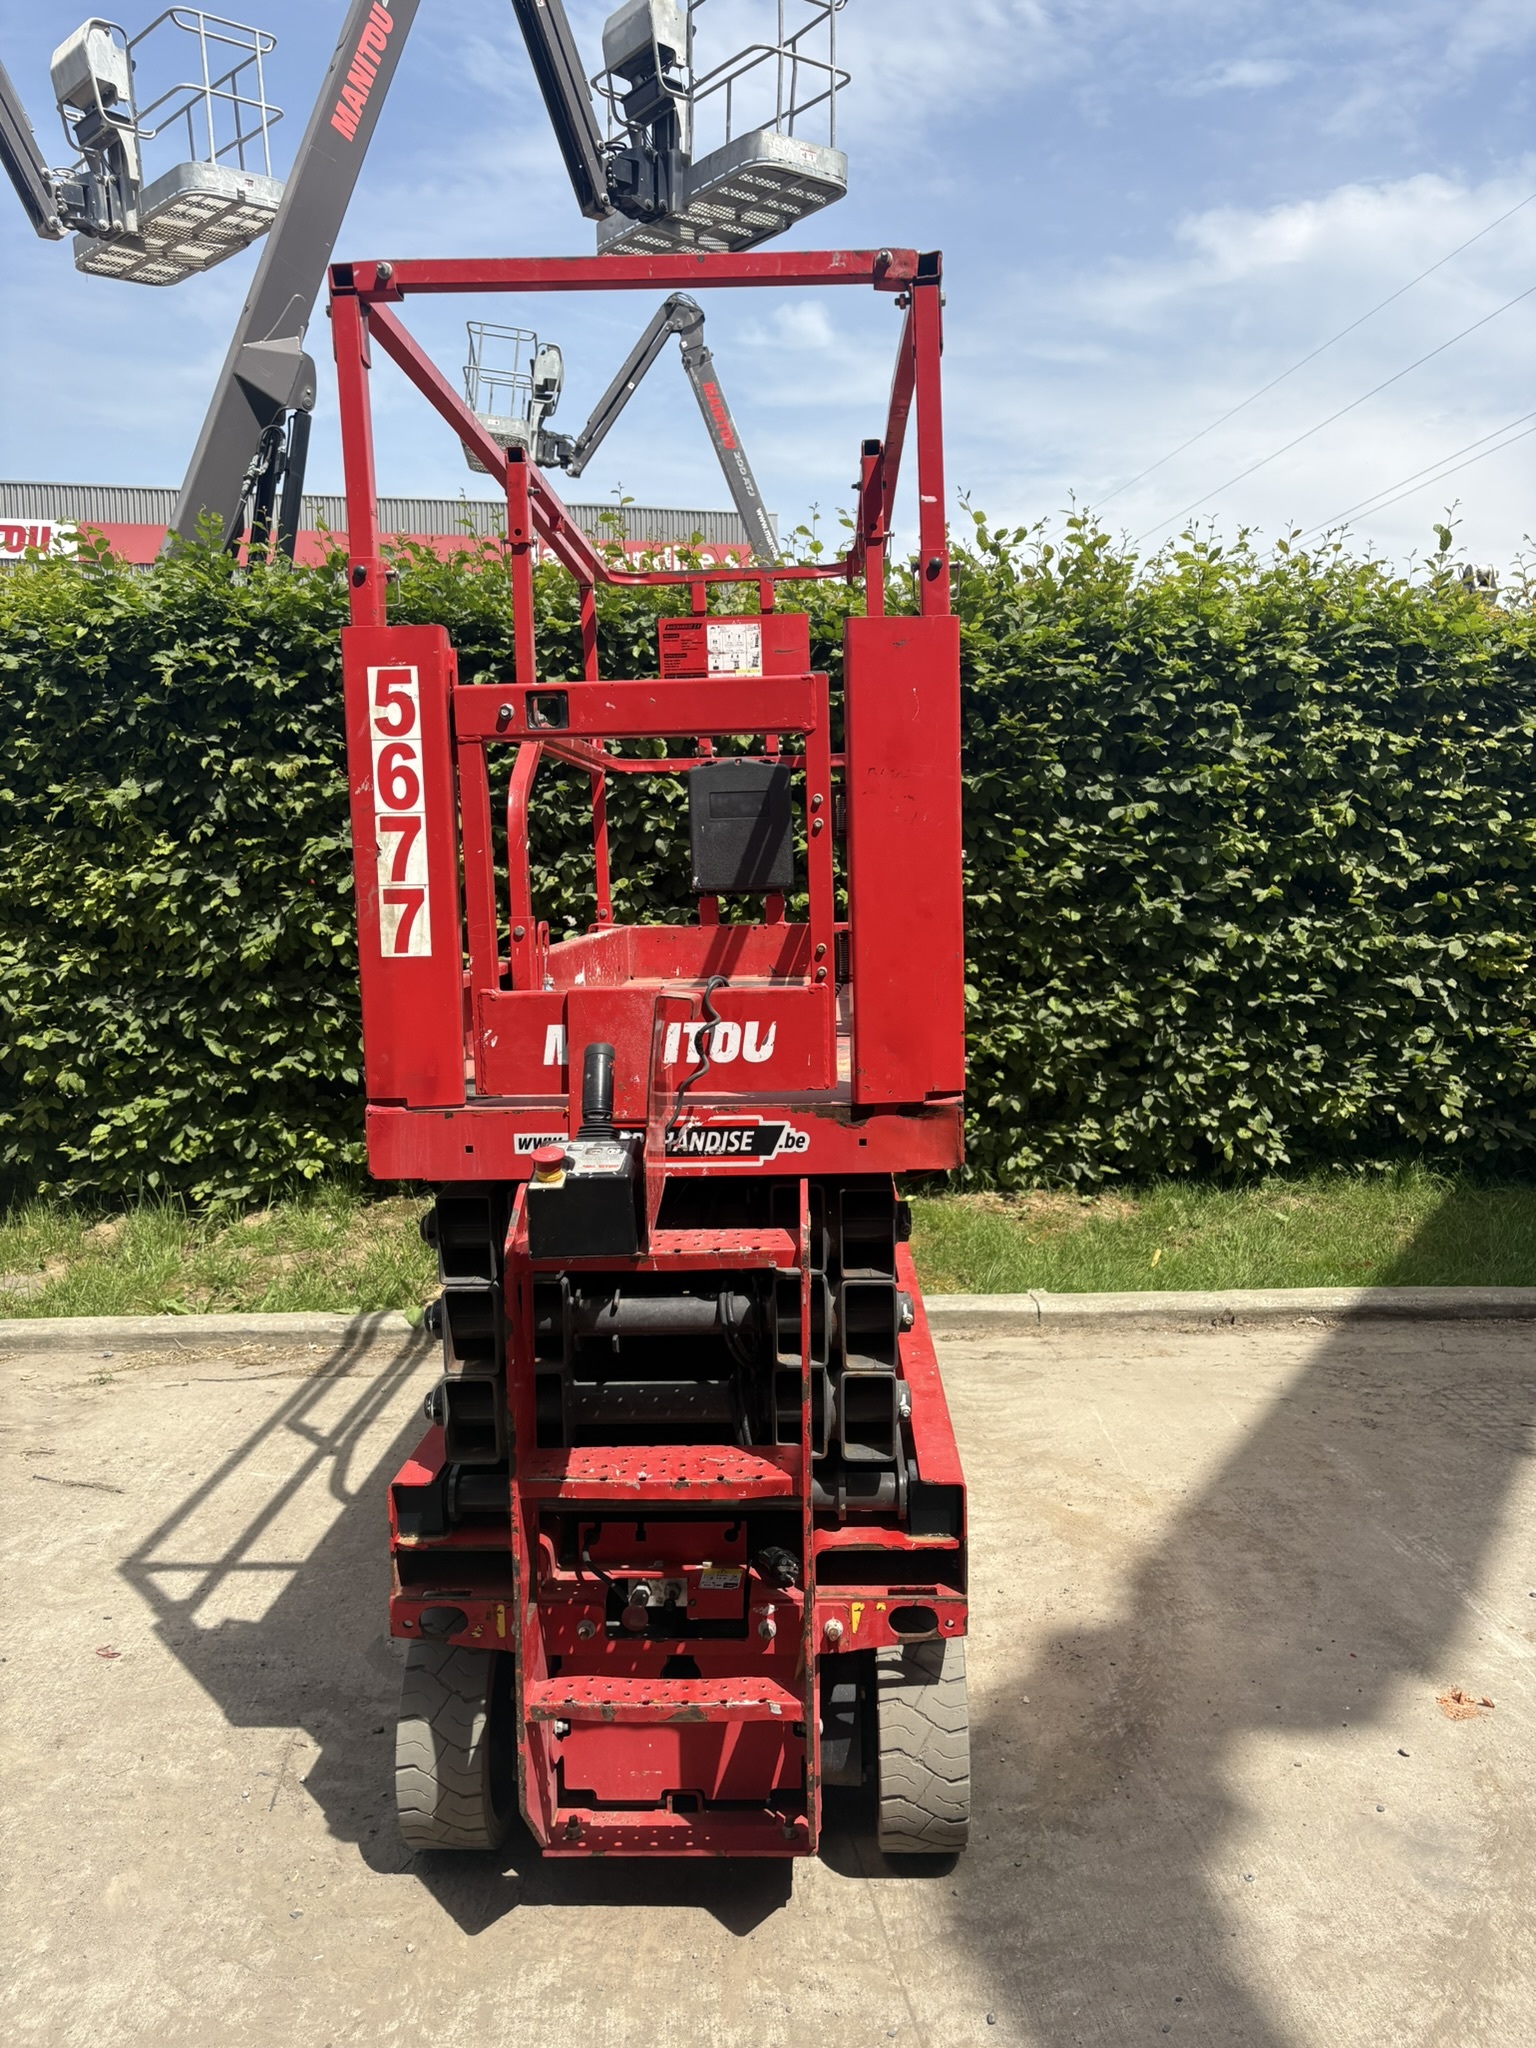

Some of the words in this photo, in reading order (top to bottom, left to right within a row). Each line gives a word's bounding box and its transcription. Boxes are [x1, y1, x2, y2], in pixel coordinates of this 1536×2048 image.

[330, 0, 394, 142] MANITOU
[702, 382, 737, 449] MANITOU
[734, 451, 747, 475] 200
[373, 669, 425, 953] 5677
[543, 1020, 777, 1067] MITOU
